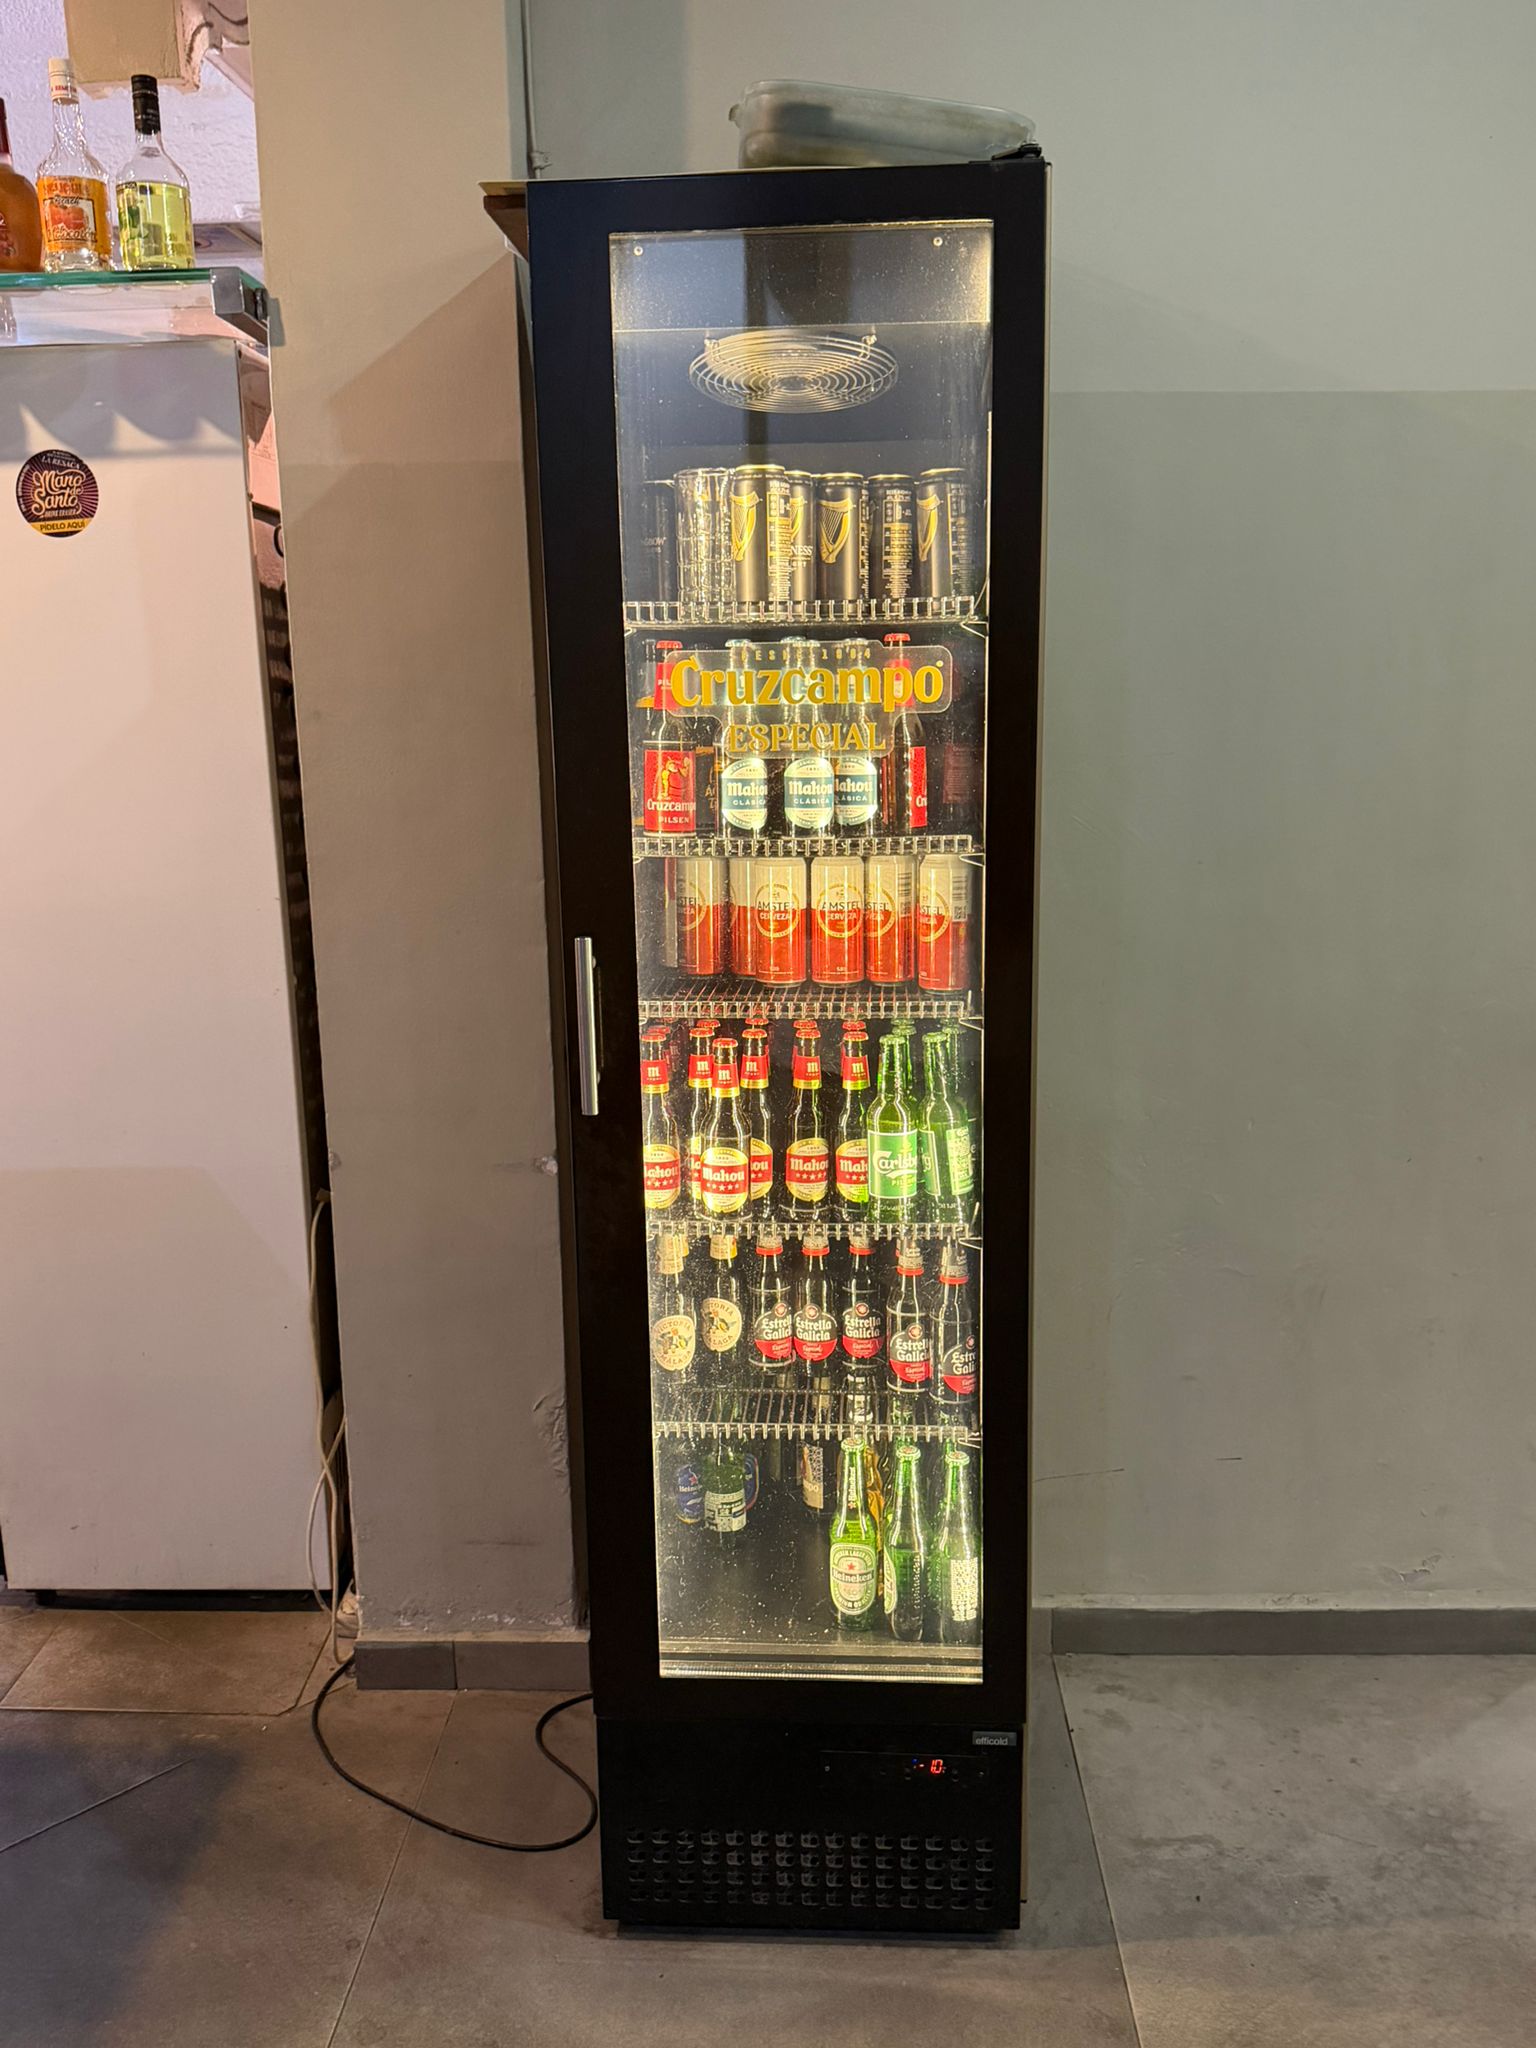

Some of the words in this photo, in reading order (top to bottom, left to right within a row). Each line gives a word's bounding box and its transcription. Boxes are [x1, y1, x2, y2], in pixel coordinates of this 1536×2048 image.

[32, 468, 86, 495] Mano
[31, 487, 82, 516] Santo
[40, 521, 66, 531] PÍDELO
[67, 519, 86, 529] AQUÍ
[671, 655, 944, 713] Cruzcampo
[728, 721, 887, 753] ESPECIAL
[702, 1167, 745, 1182] Mahou
[795, 1316, 832, 1331] Estrella
[844, 1314, 881, 1328] Estrella
[795, 1328, 831, 1342] Galicia
[845, 1327, 880, 1339] Galicia
[832, 1568, 873, 1583] Heineken
[975, 1736, 1009, 1747] efficold
